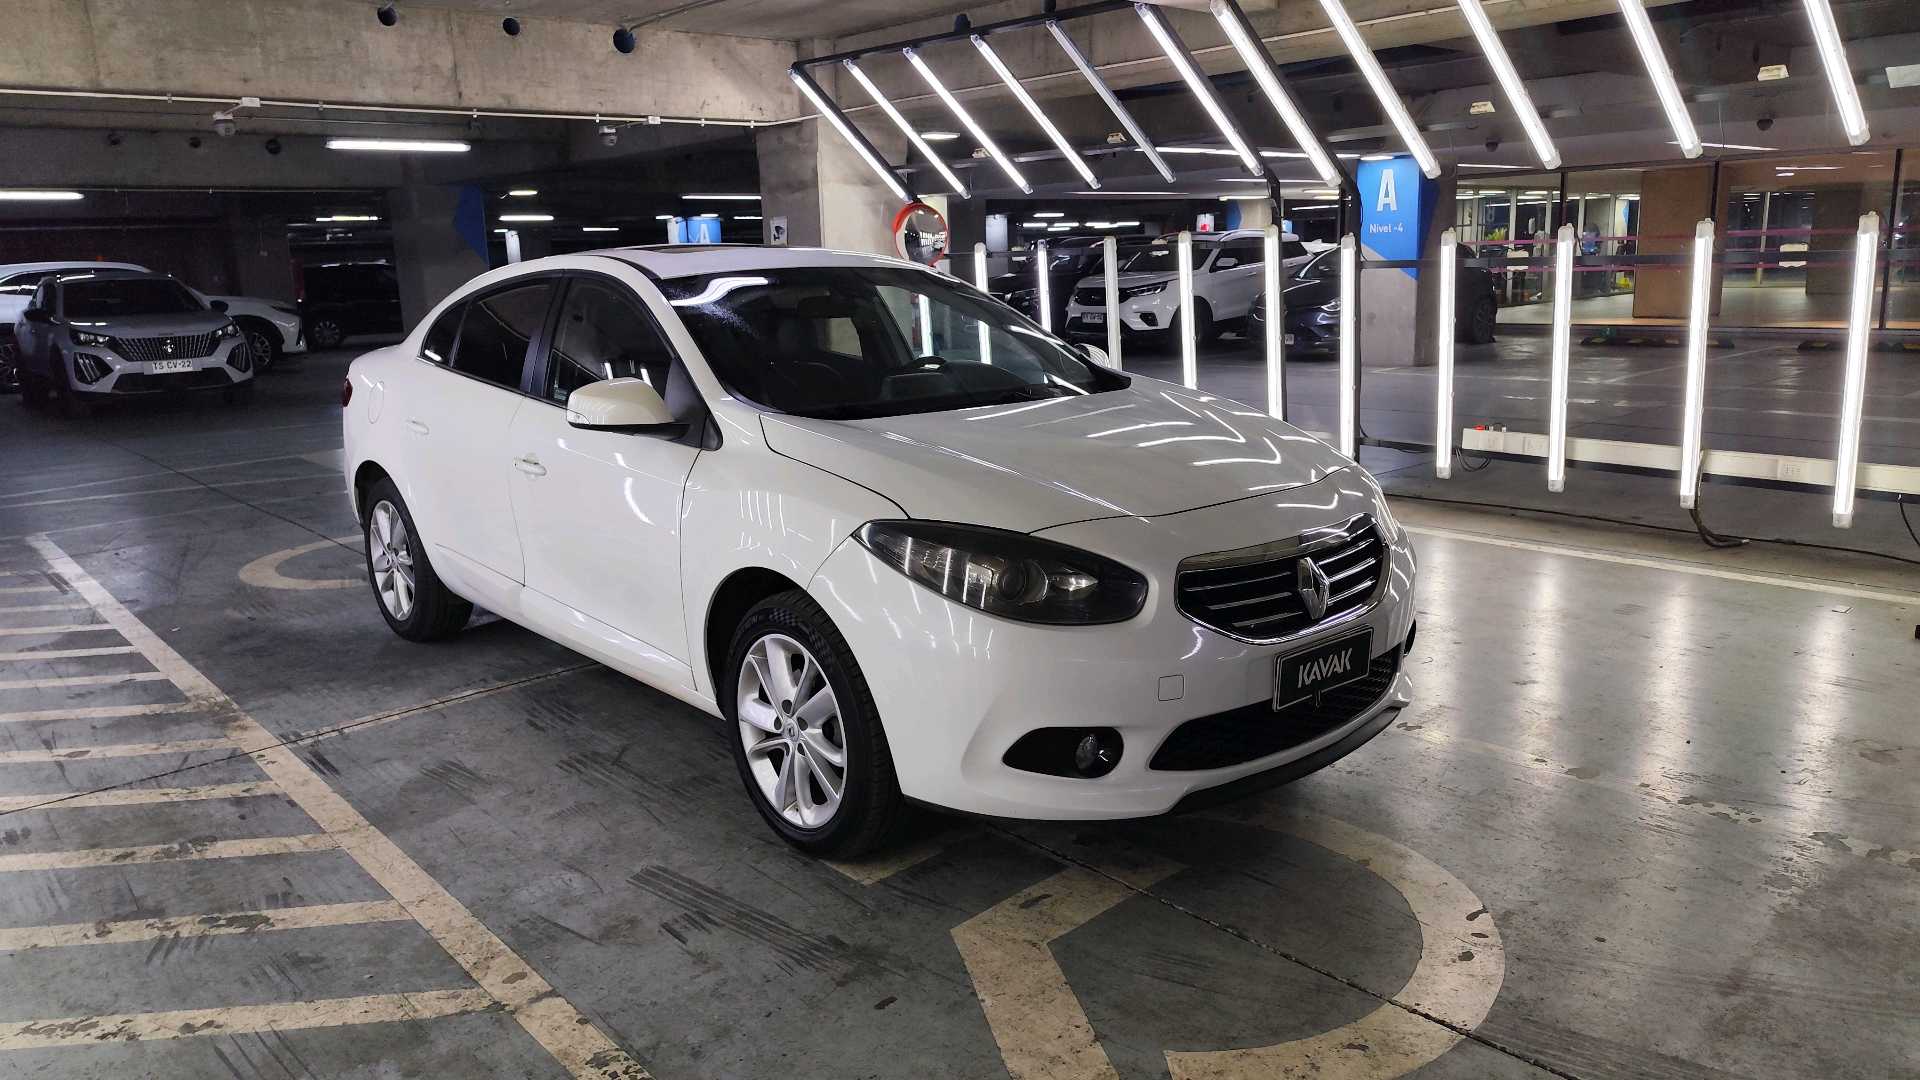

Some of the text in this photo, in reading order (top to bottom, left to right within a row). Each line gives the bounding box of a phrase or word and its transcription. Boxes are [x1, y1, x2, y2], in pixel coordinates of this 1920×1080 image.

[1376, 168, 1398, 212] A
[1369, 222, 1404, 233] Nivel -4
[1297, 647, 1353, 689] KAVAK
